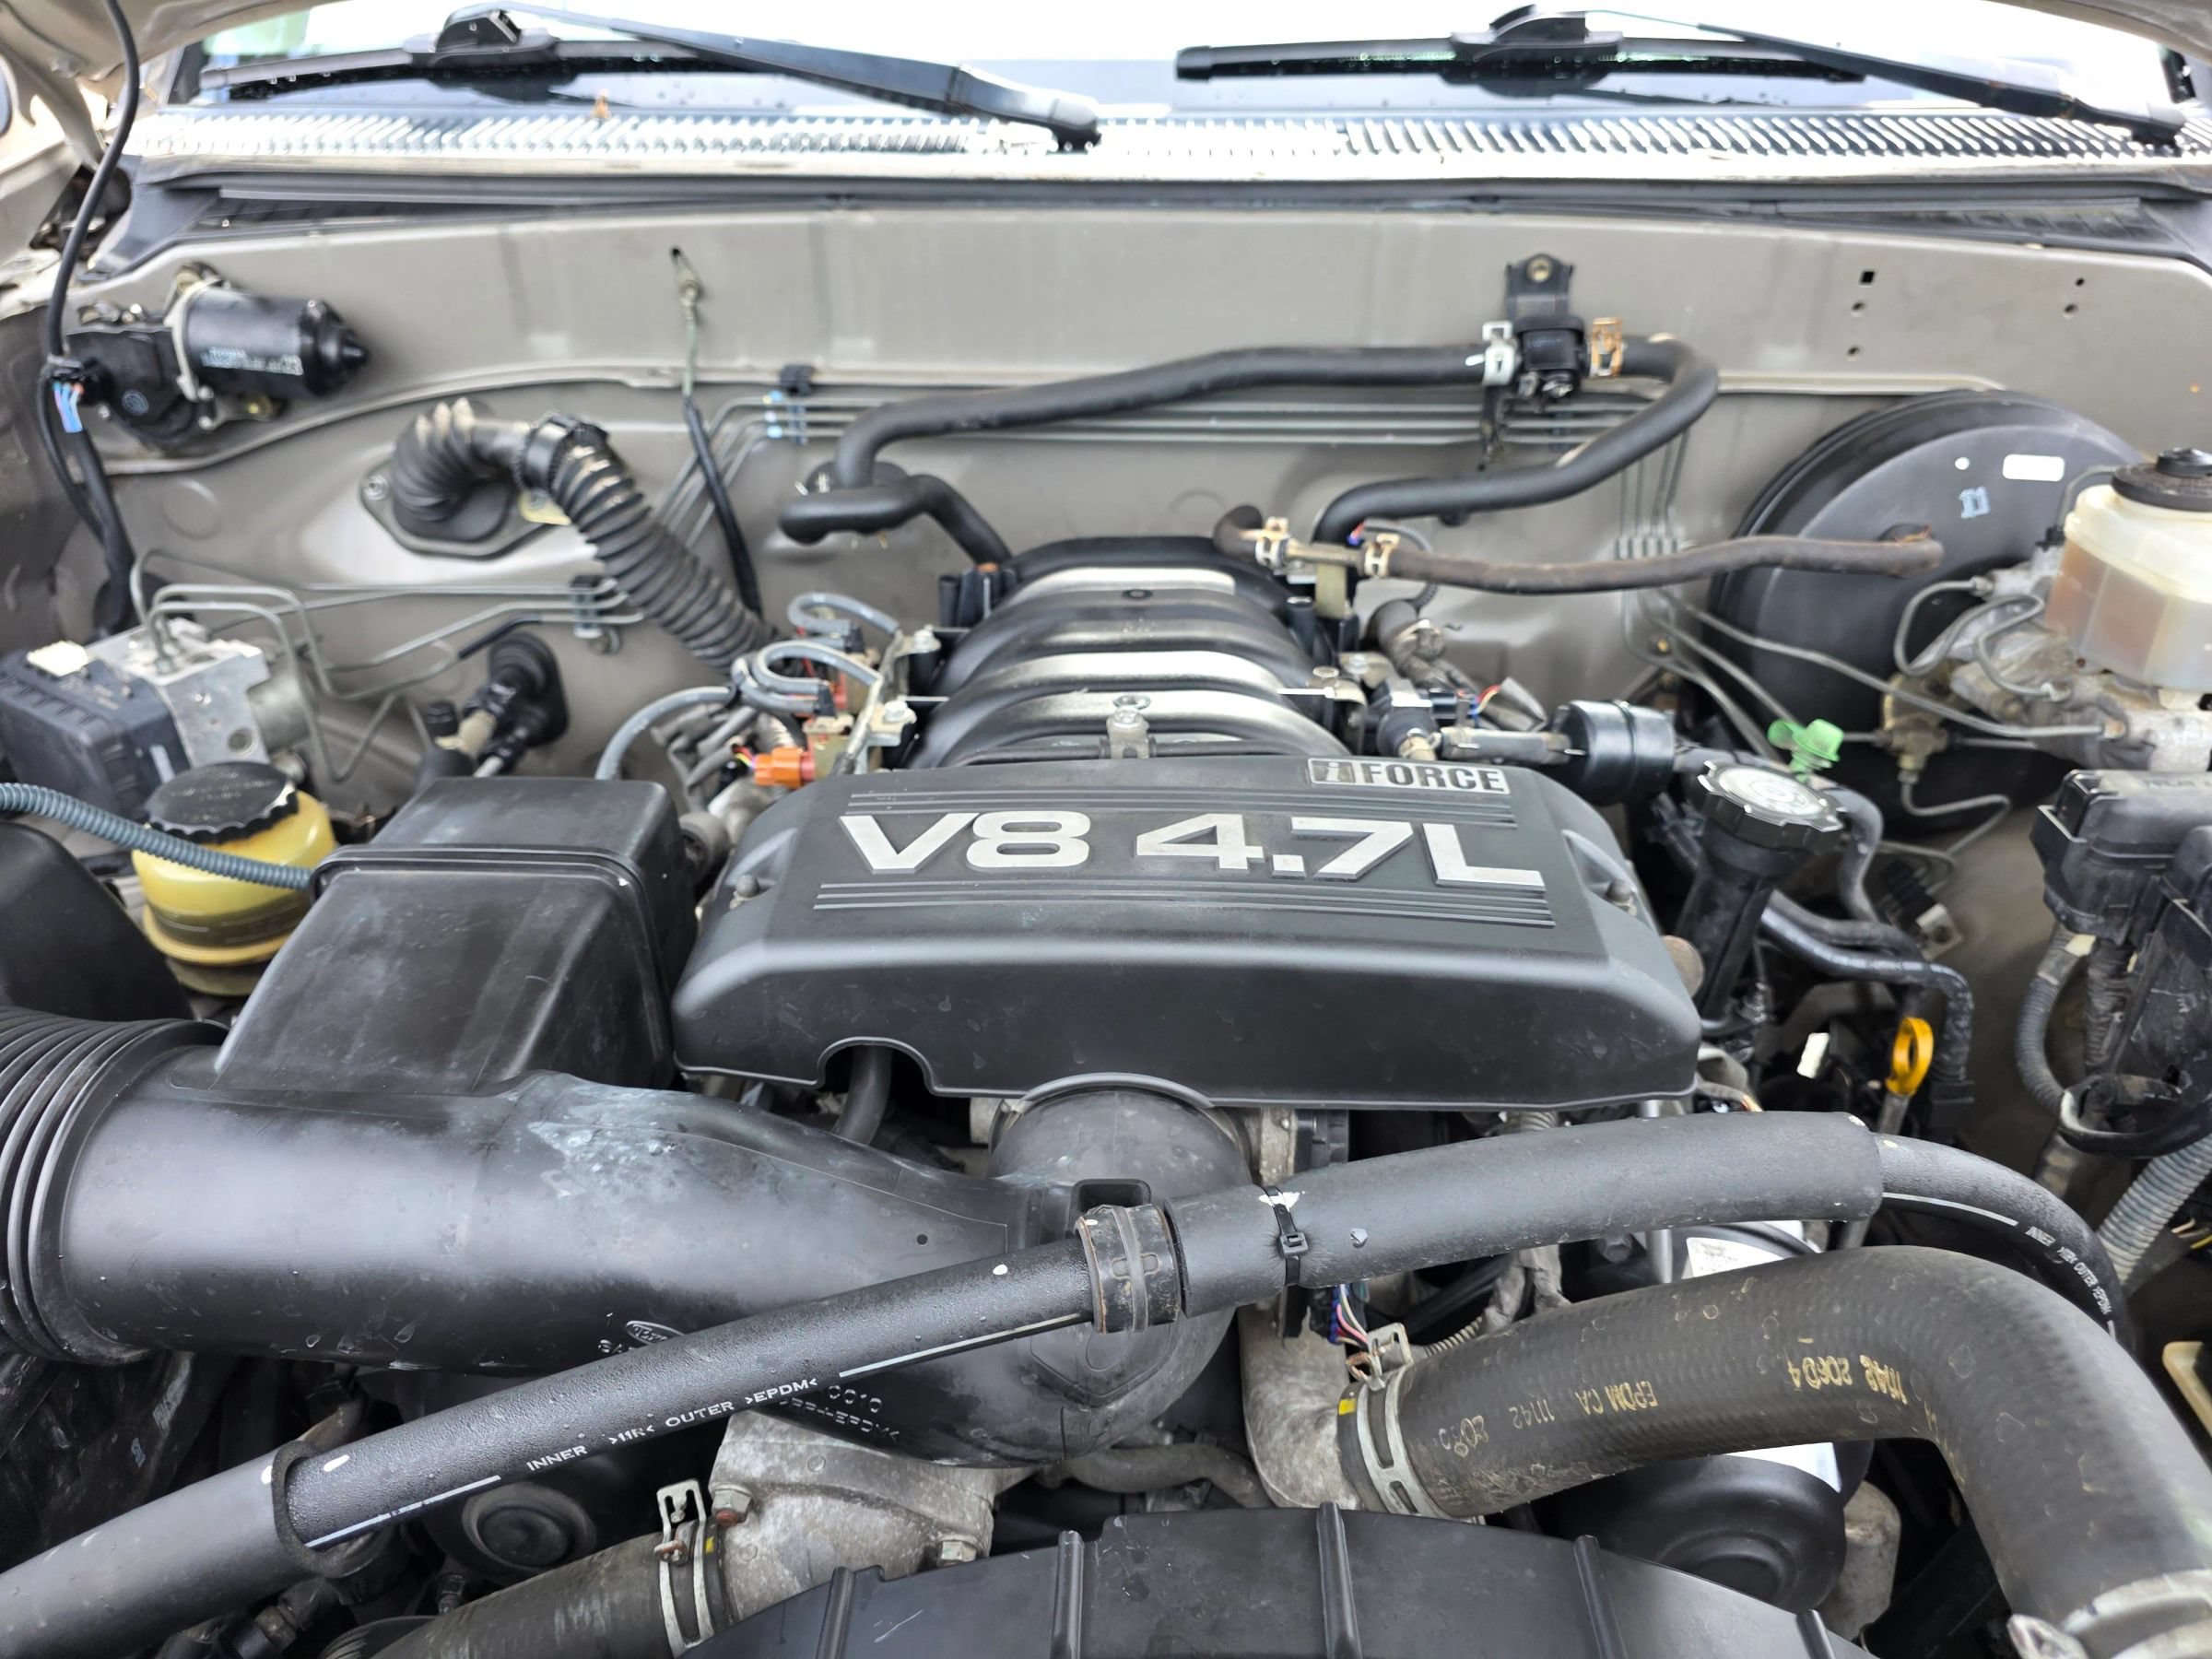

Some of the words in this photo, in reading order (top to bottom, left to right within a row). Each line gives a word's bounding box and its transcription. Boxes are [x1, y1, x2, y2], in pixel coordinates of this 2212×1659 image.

[1359, 761, 1505, 793] FORCE
[840, 810, 1091, 873] V8
[1135, 812, 1546, 888] 4.7L
[1574, 1388, 1604, 1415] CA
[1605, 1381, 1658, 1412] EPDM
[527, 1443, 588, 1472] INNER
[665, 1400, 735, 1427] OUTER
